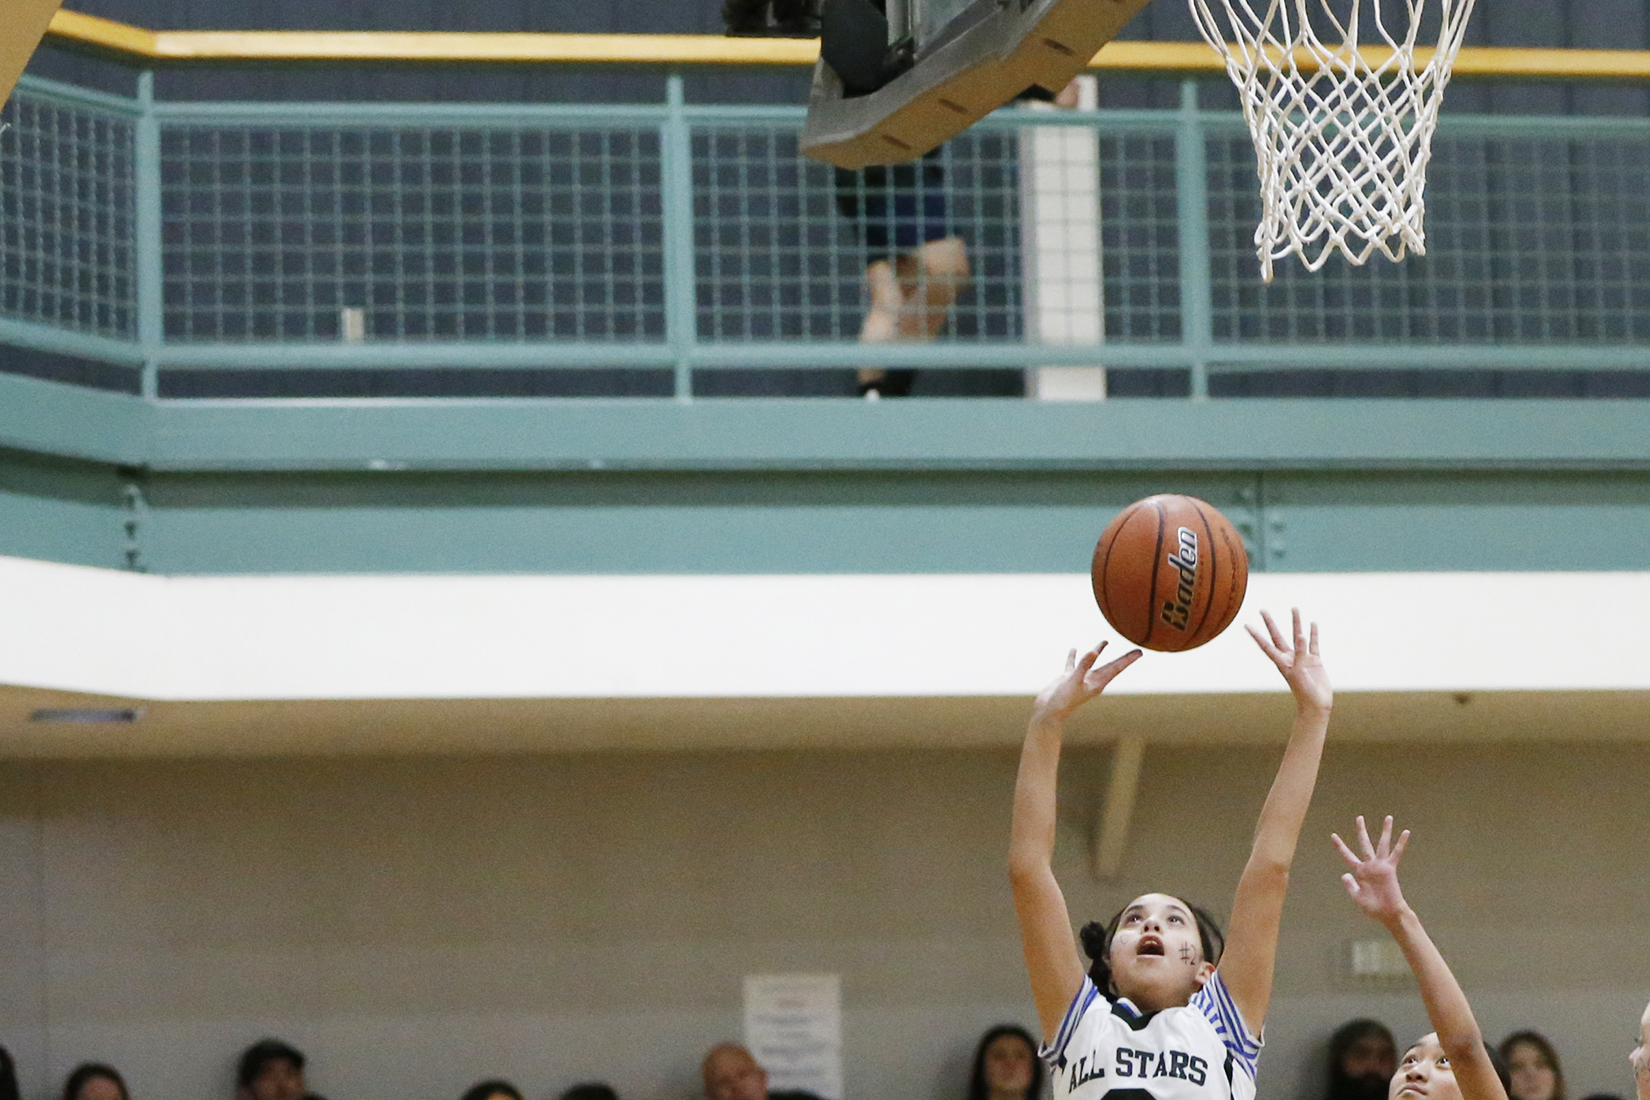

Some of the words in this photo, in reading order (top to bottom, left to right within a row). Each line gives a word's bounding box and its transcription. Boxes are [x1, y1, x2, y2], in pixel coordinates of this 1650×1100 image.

[1161, 526, 1197, 632] Baden
[1068, 1050, 1104, 1094] ALL
[1116, 1047, 1208, 1087] STARS
